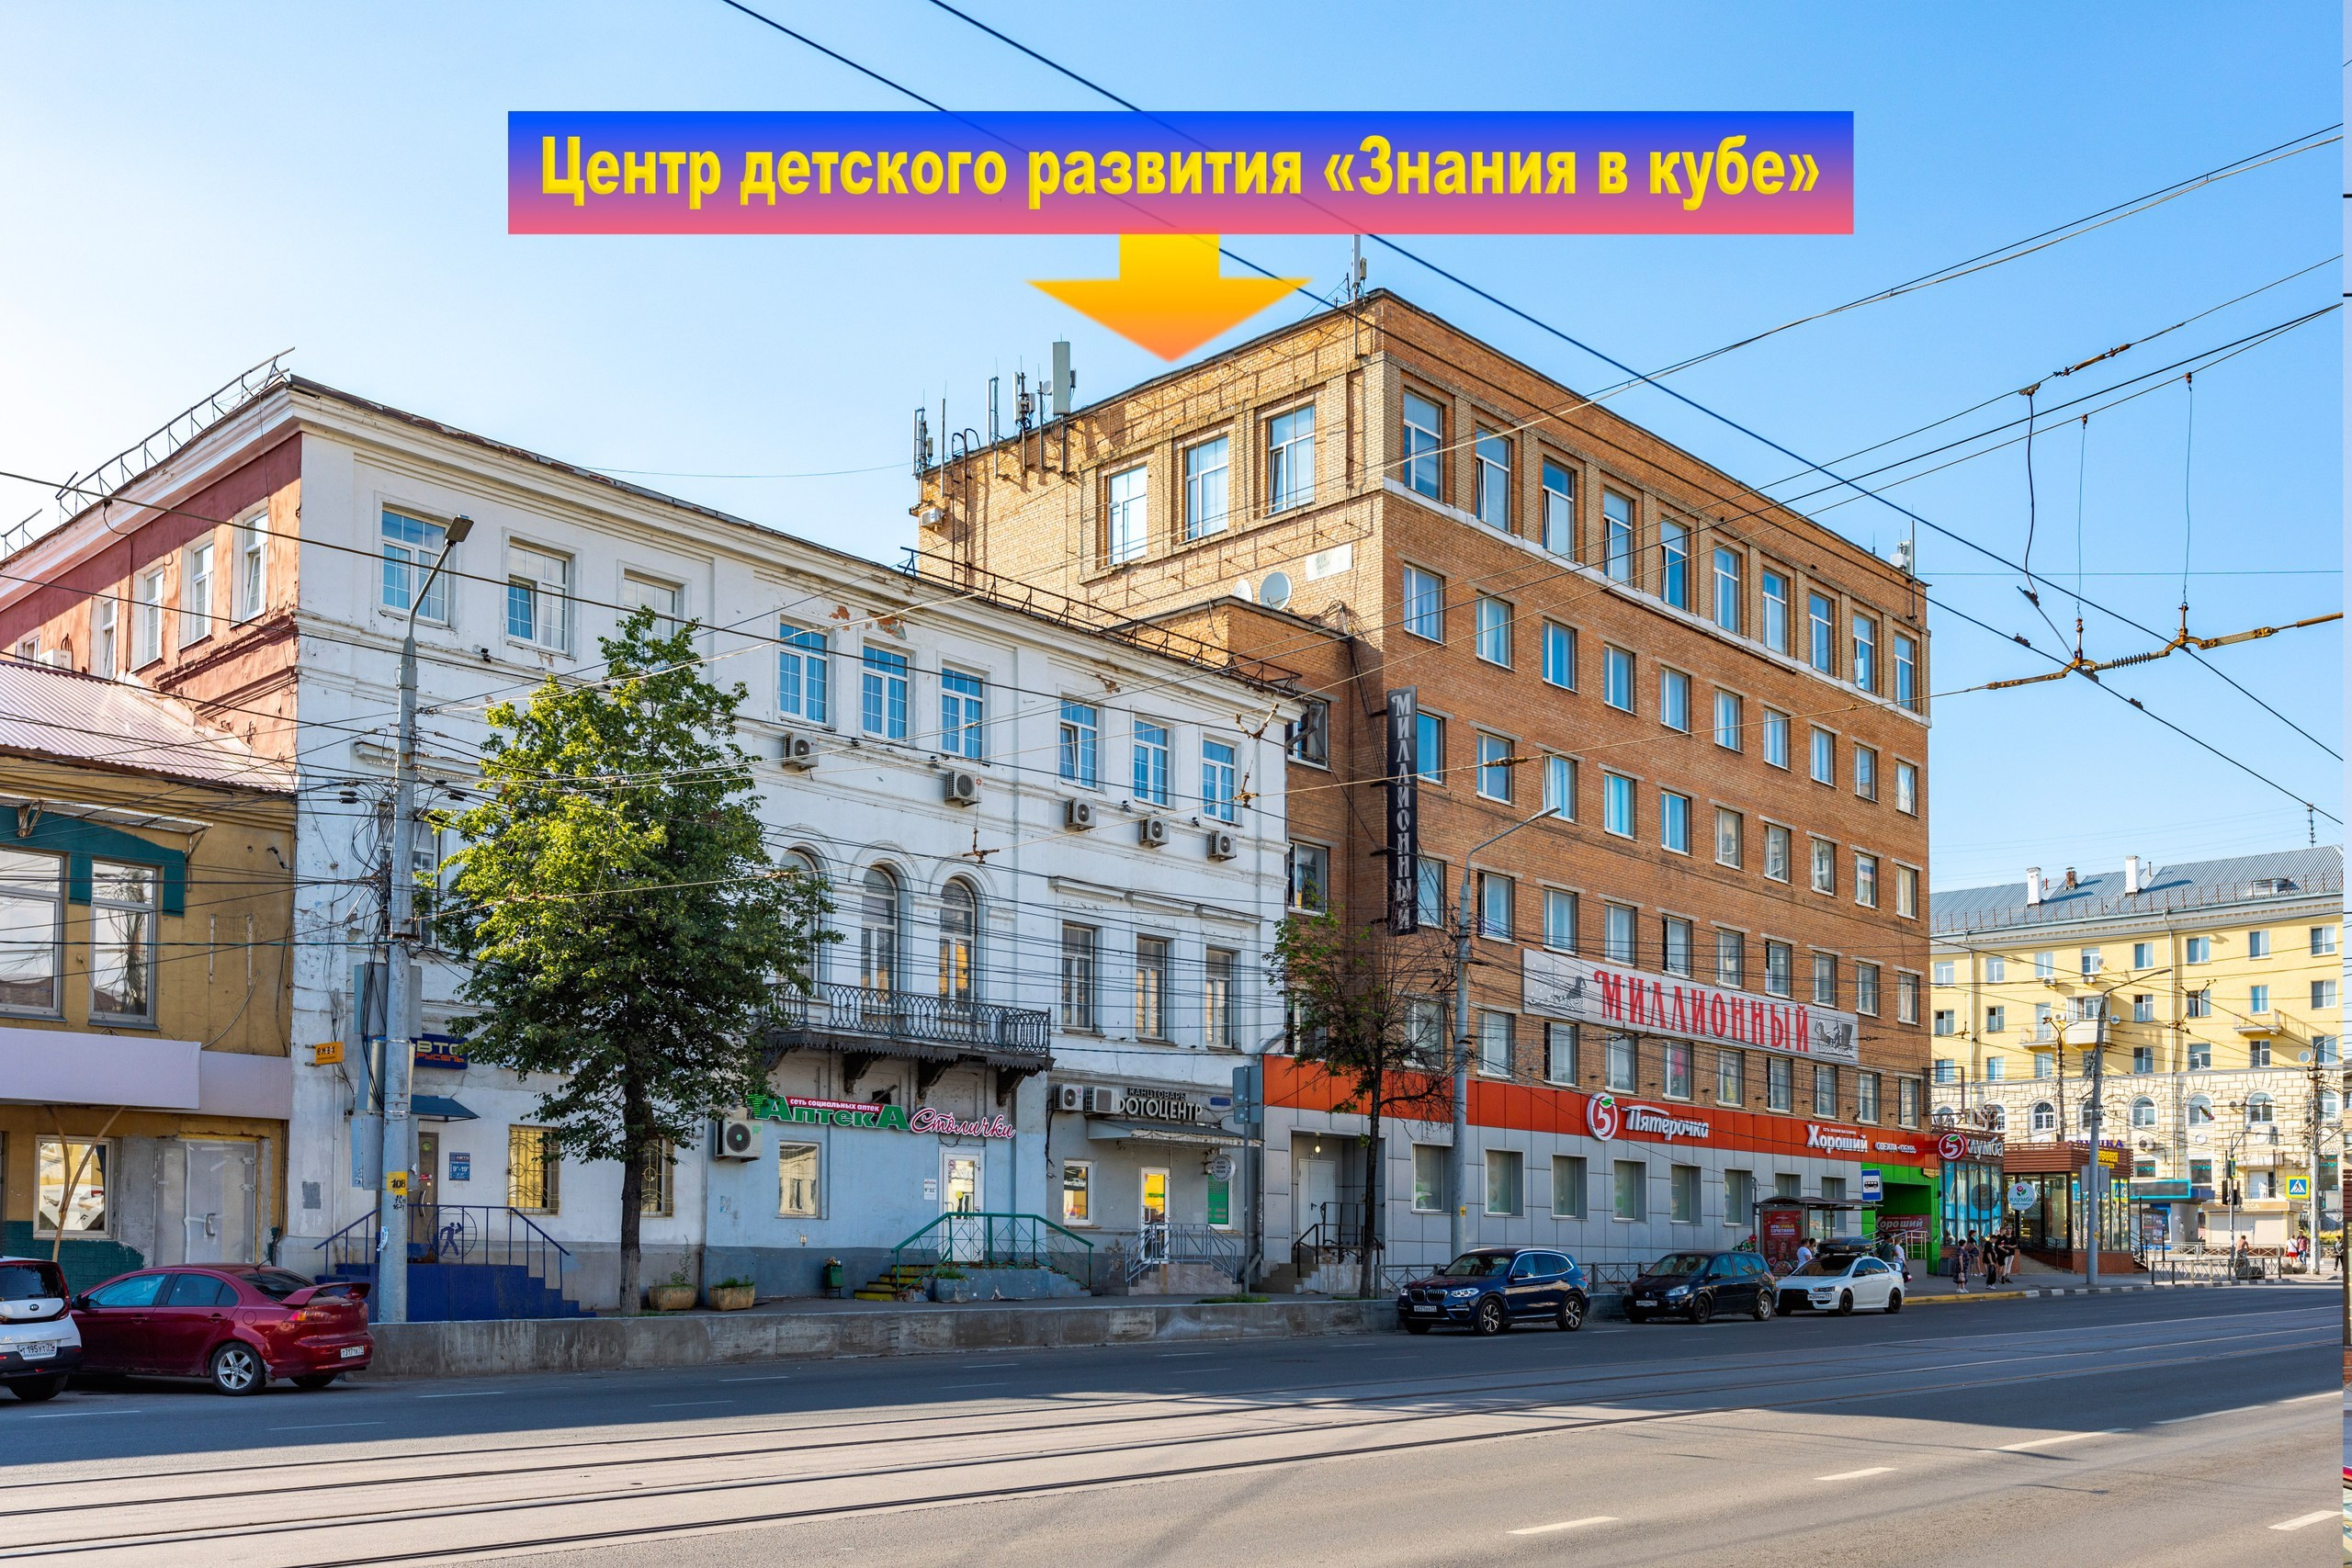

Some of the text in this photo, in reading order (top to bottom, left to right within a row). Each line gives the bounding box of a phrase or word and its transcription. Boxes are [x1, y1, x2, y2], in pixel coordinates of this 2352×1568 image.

[1391, 693, 1412, 931] МИЛЛИОННЫЙ
[1594, 969, 1810, 1054] МИЛЛИОННЫЙ
[416, 1040, 462, 1056] ВТО
[790, 1098, 879, 1112] сеть социальных аптек
[910, 1107, 1016, 1139] Столички
[1621, 1105, 1710, 1141] Пятерочка
[1806, 1123, 1868, 1154] Хороший
